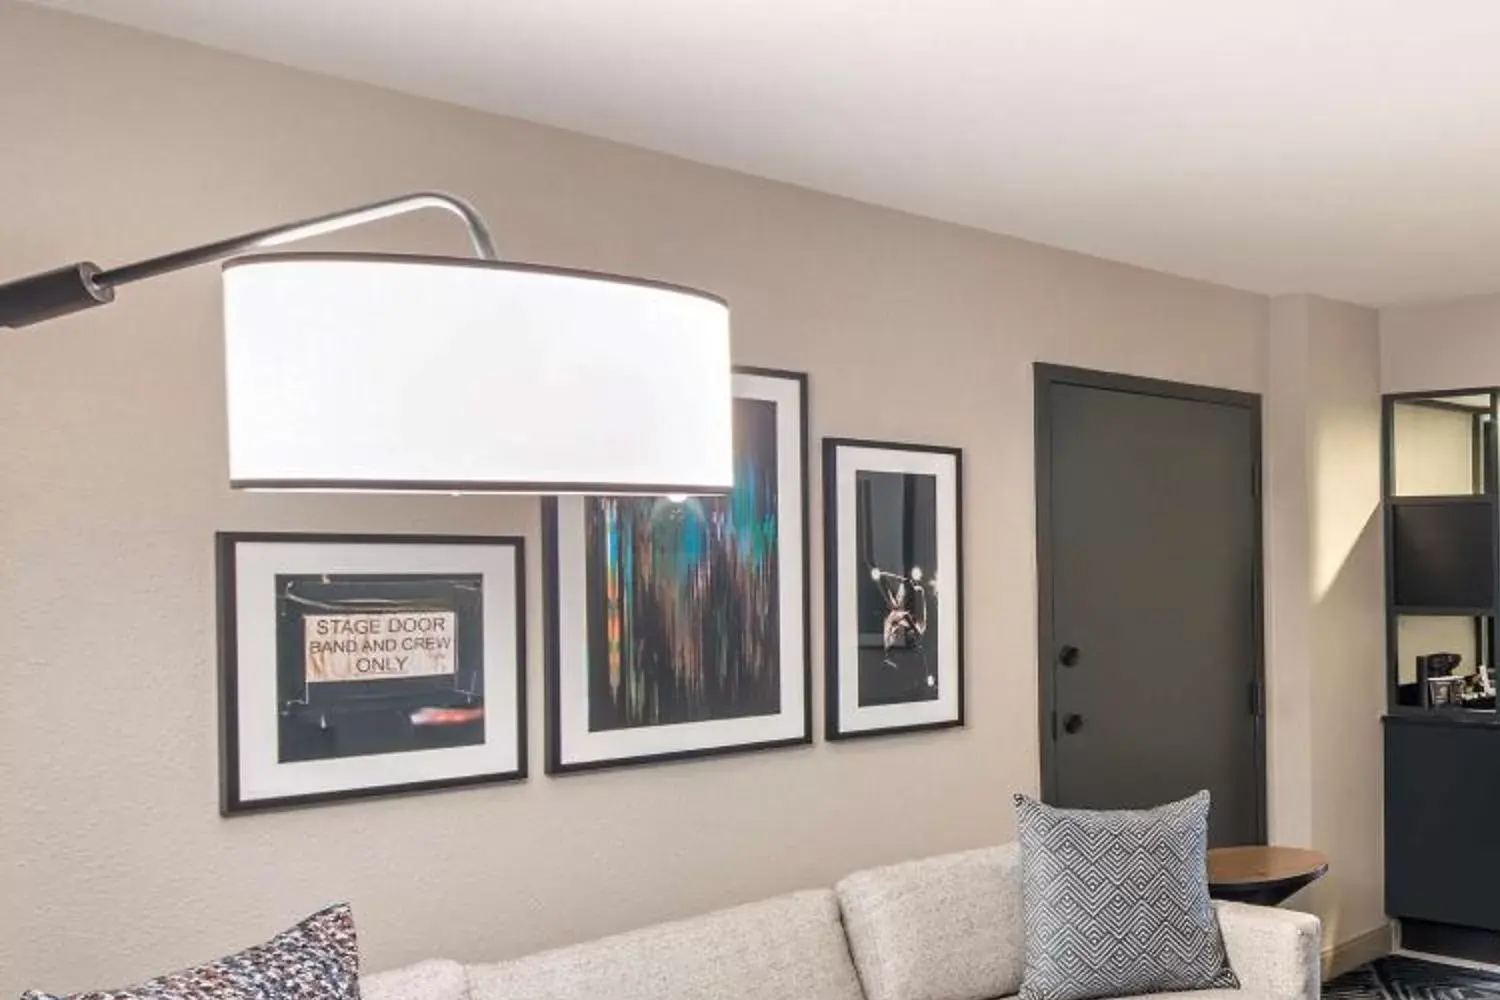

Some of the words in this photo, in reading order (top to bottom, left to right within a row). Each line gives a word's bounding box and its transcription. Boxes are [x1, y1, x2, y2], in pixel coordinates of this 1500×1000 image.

[317, 619, 380, 635] STAGE
[388, 617, 445, 633] DOOR
[310, 640, 357, 654] BAND
[362, 639, 397, 652] AND
[401, 637, 451, 651] CREW
[356, 656, 408, 673] ONLY
